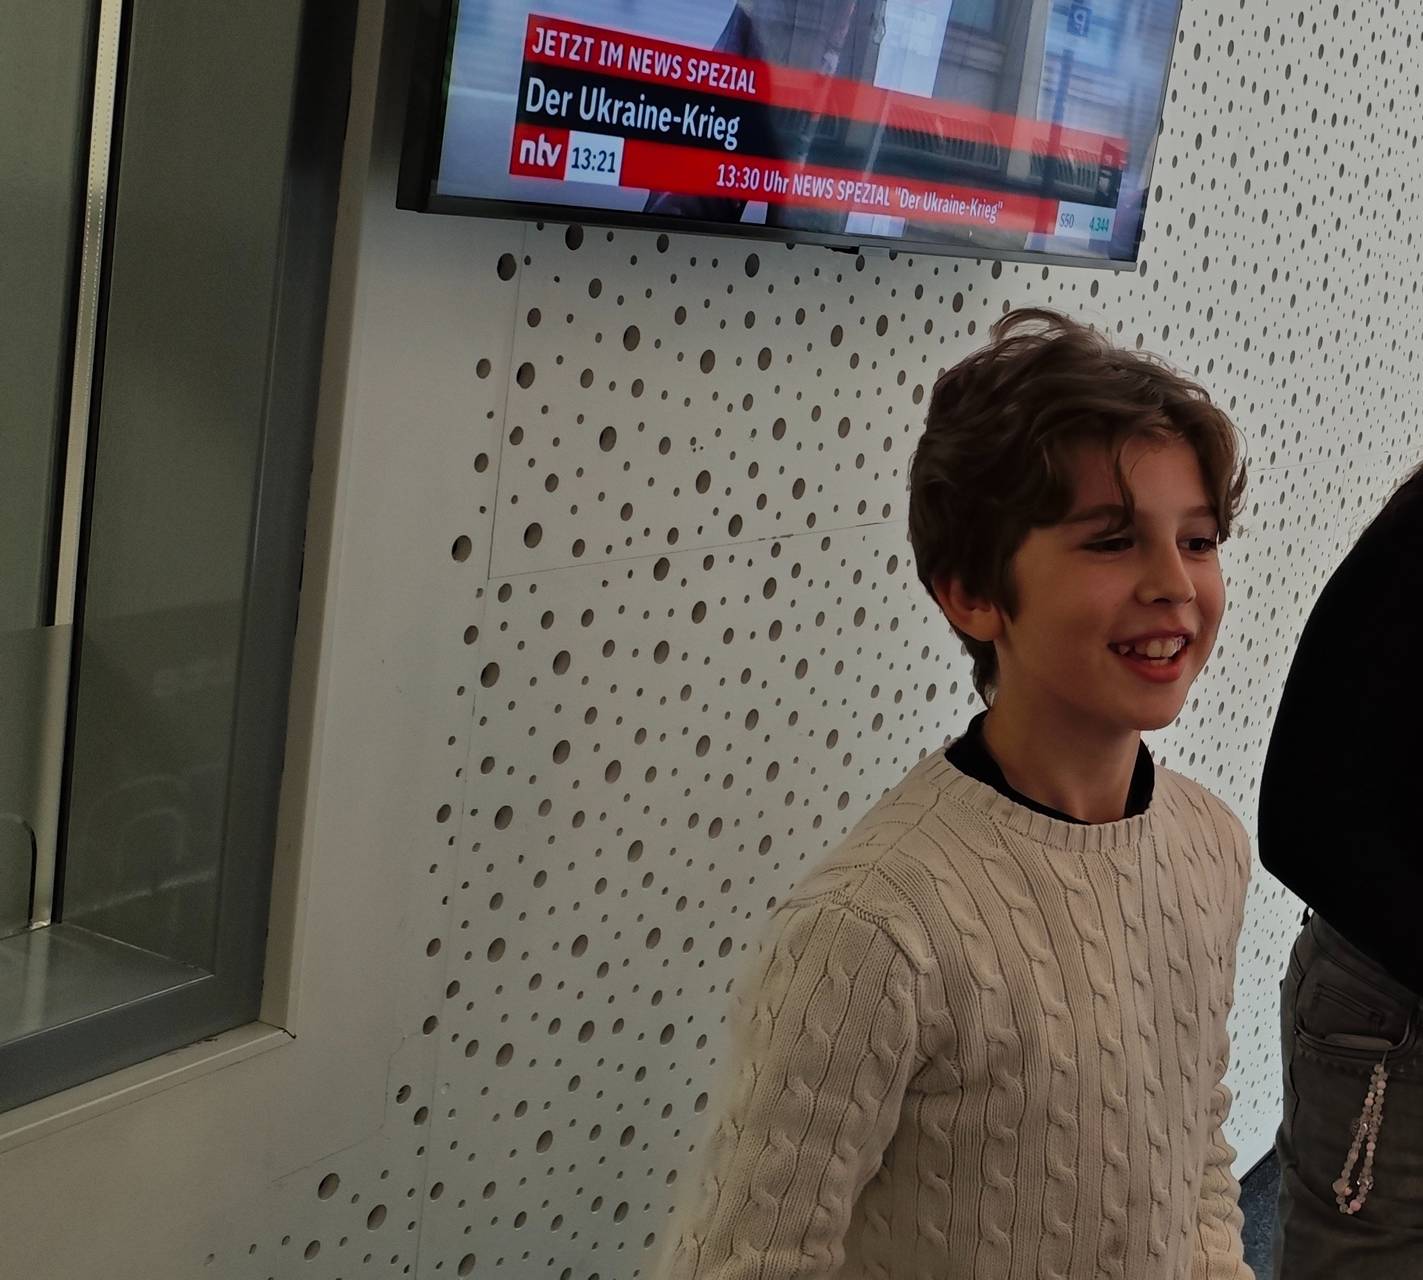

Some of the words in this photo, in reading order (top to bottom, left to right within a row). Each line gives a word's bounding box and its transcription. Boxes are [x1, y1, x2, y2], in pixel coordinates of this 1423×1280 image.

[532, 27, 594, 63] JETZT
[598, 40, 623, 68] IM
[627, 47, 682, 80] NEWS
[686, 58, 756, 94] SPEZIAL
[525, 76, 572, 117] Der
[579, 85, 741, 151] Ukraine-Krieg
[519, 133, 562, 168] ntv
[571, 147, 616, 173] 13:21
[716, 163, 760, 191] 13:30
[763, 173, 790, 195] Uhr
[792, 175, 833, 200] NEWS
[837, 180, 891, 207] SPEZIAL
[895, 183, 921, 211] "Der
[923, 192, 1003, 224] Ukraine-Krieg"
